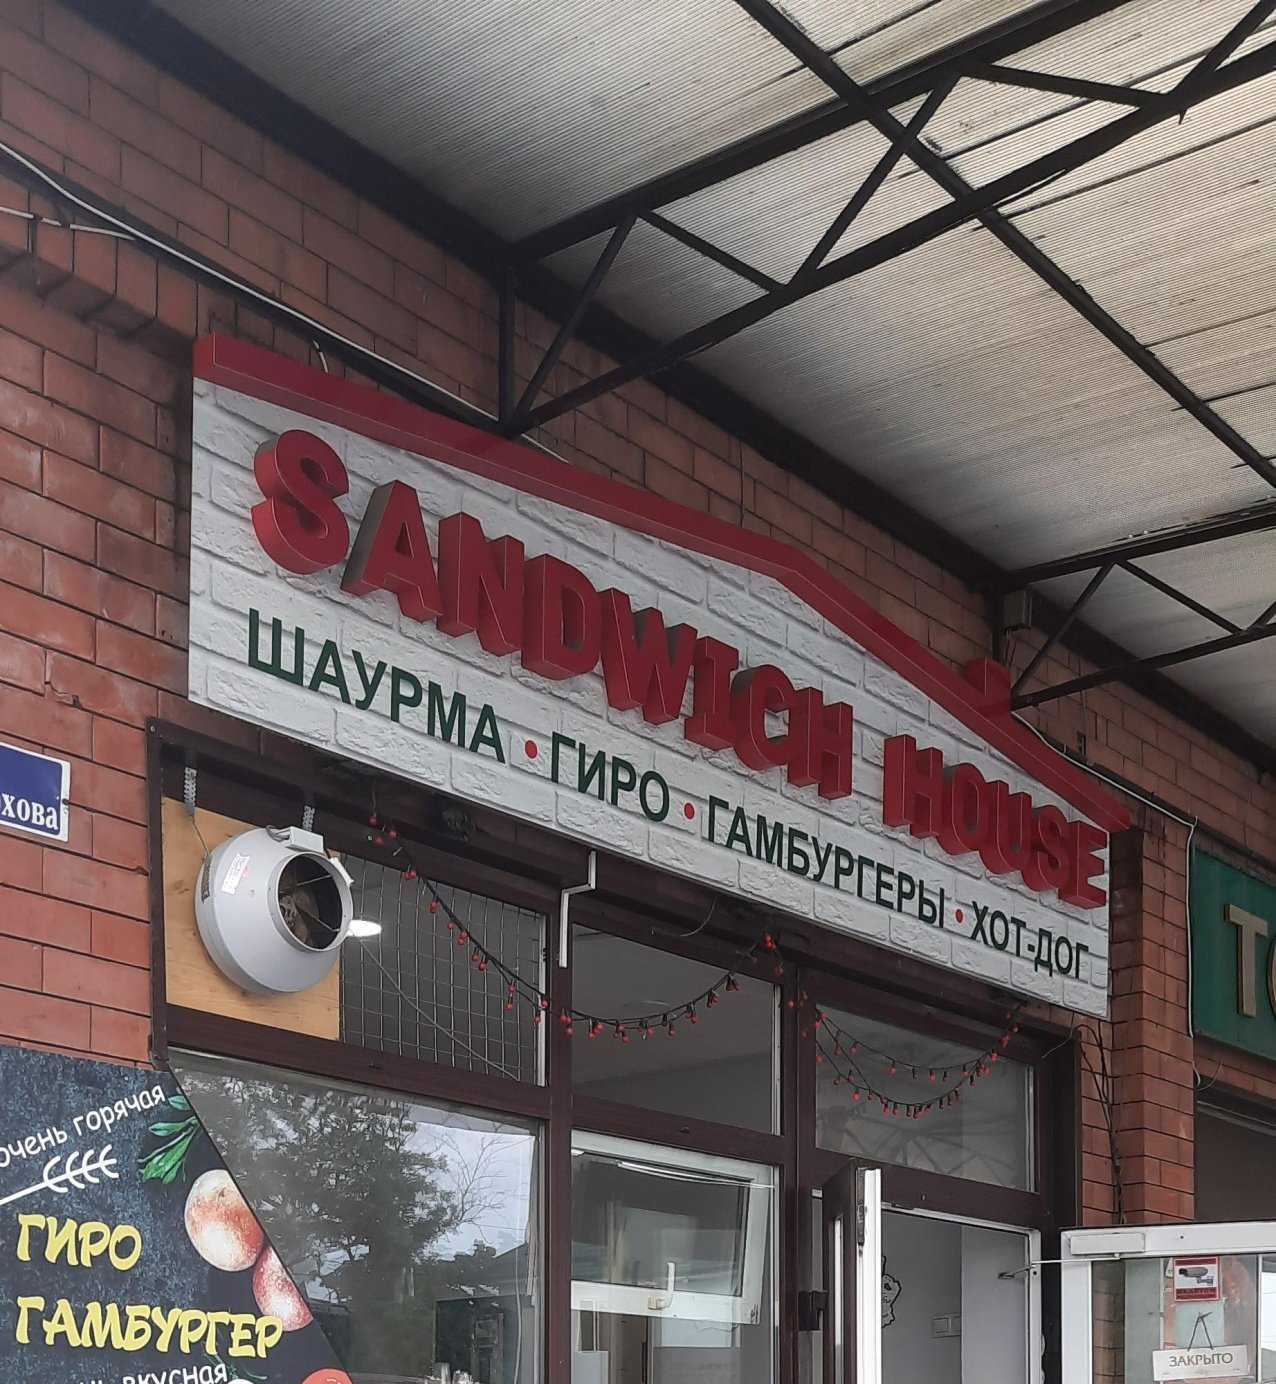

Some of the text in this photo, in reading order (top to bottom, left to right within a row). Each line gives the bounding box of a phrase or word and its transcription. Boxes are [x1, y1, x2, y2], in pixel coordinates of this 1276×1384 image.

[251, 429, 1107, 909] SANDWICH HOUSE
[0, 793, 58, 830] хова
[248, 608, 1089, 982] ШАУРМА ГИРО ГАМБУРГЕРЫ ХОТ-ДОГ
[73, 1084, 166, 1142] горячая
[15, 1214, 142, 1270] ГИРО
[14, 1296, 283, 1358] ГАМБУРГЕР
[1168, 1352, 1233, 1368] ЗАКРЫТО
